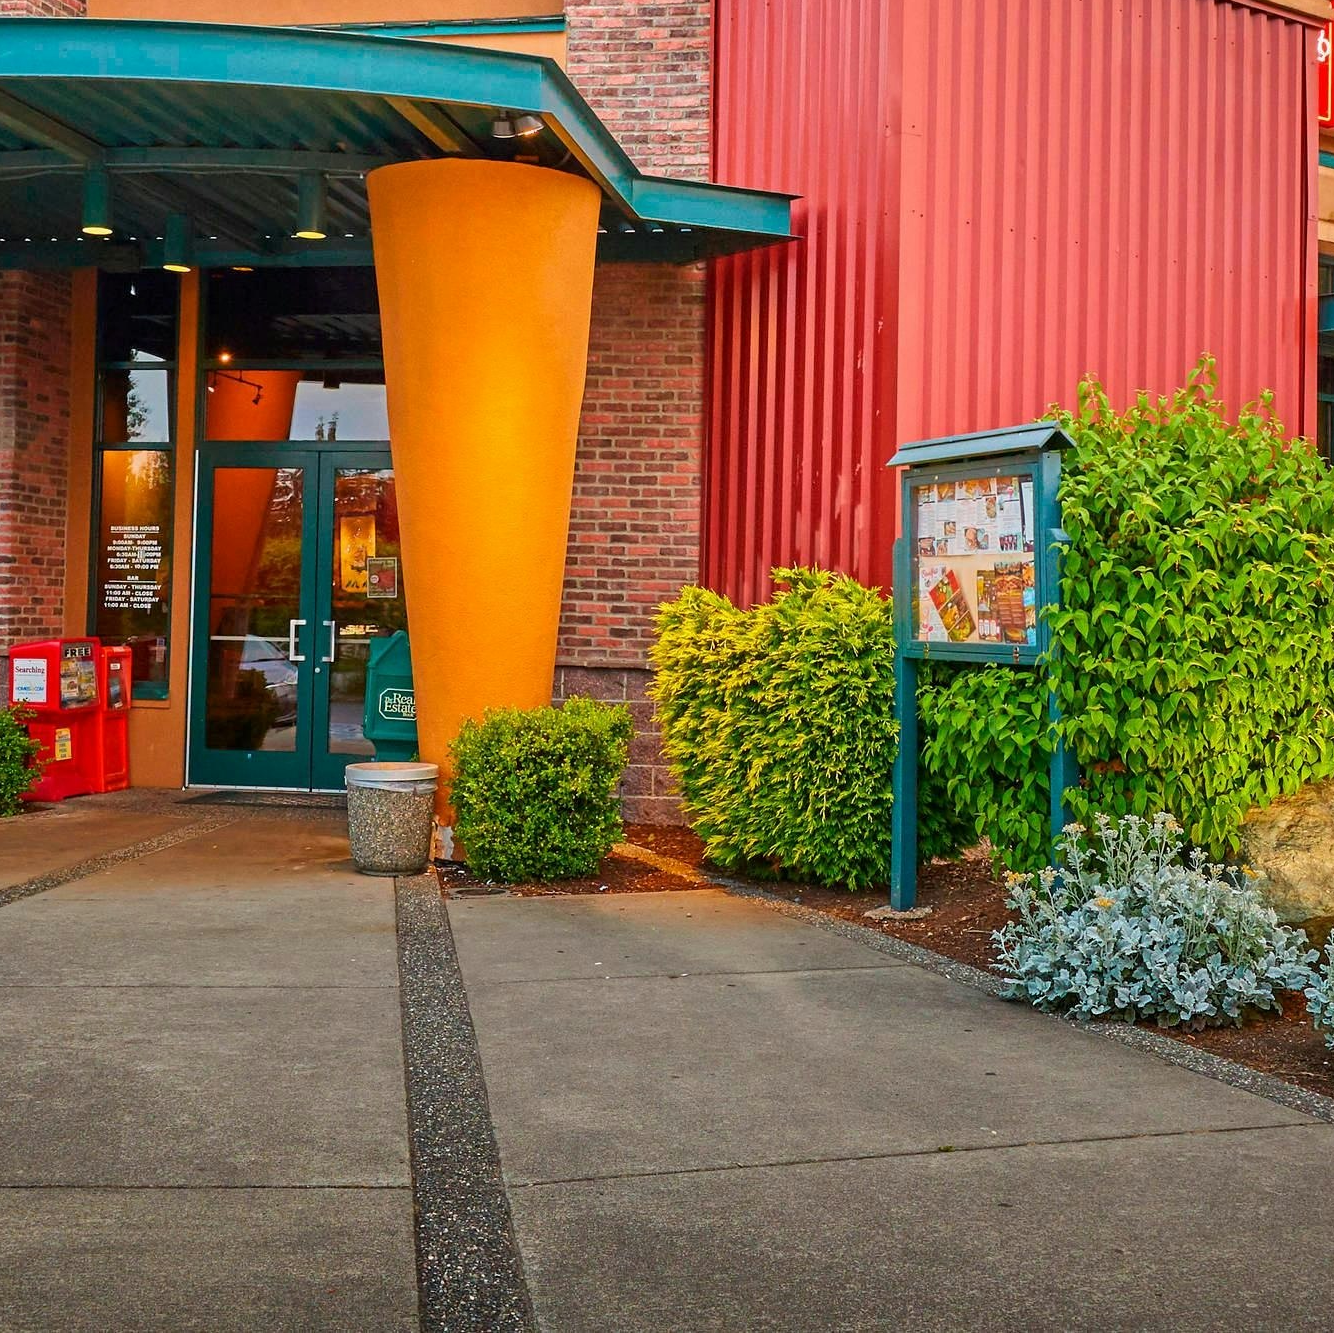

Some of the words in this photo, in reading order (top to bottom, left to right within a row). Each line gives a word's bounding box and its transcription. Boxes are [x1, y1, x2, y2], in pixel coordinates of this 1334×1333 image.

[64, 647, 91, 658] FREE
[15, 666, 45, 674] Searching
[384, 702, 417, 714] Estate
